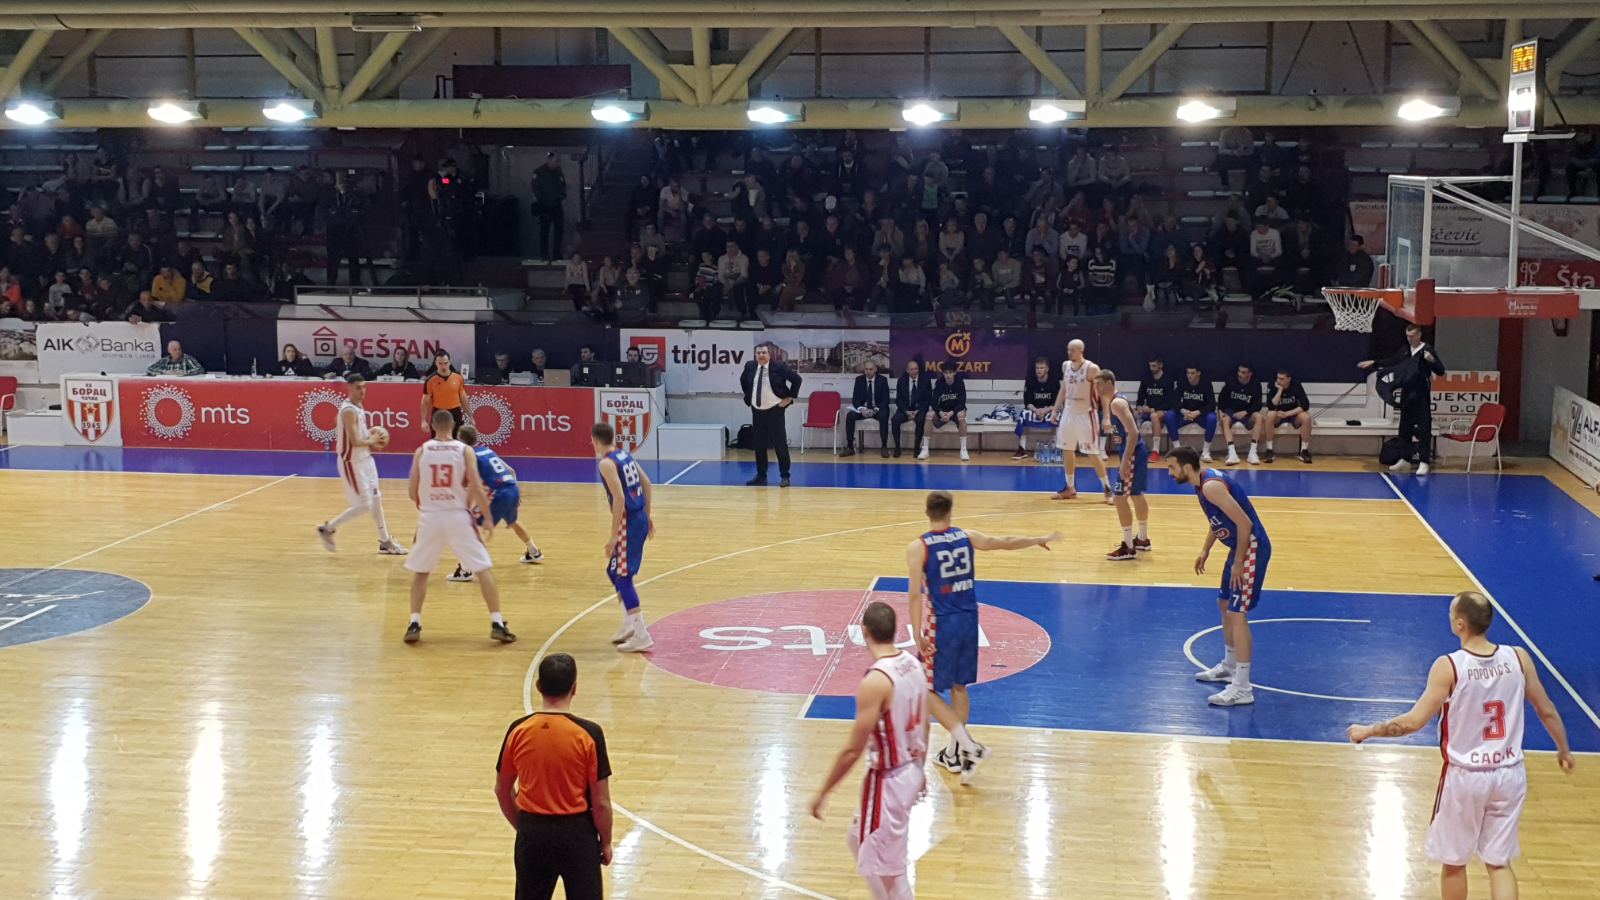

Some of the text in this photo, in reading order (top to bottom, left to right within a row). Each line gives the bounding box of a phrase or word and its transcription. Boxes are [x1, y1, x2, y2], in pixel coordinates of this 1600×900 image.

[43, 338, 155, 352] AIK Banka
[671, 343, 744, 371] triglav
[72, 387, 107, 397] БОРАЦ
[201, 403, 250, 425] mts
[606, 400, 644, 409] БОРАЦ
[82, 421, 101, 429] 1945
[365, 407, 410, 429] mts
[520, 410, 571, 432] mts
[616, 435, 636, 443] 1945
[489, 456, 505, 474] 8
[429, 463, 453, 488] 13
[936, 546, 971, 578] 23
[1232, 594, 1240, 607] 7
[1482, 700, 1506, 741] 3
